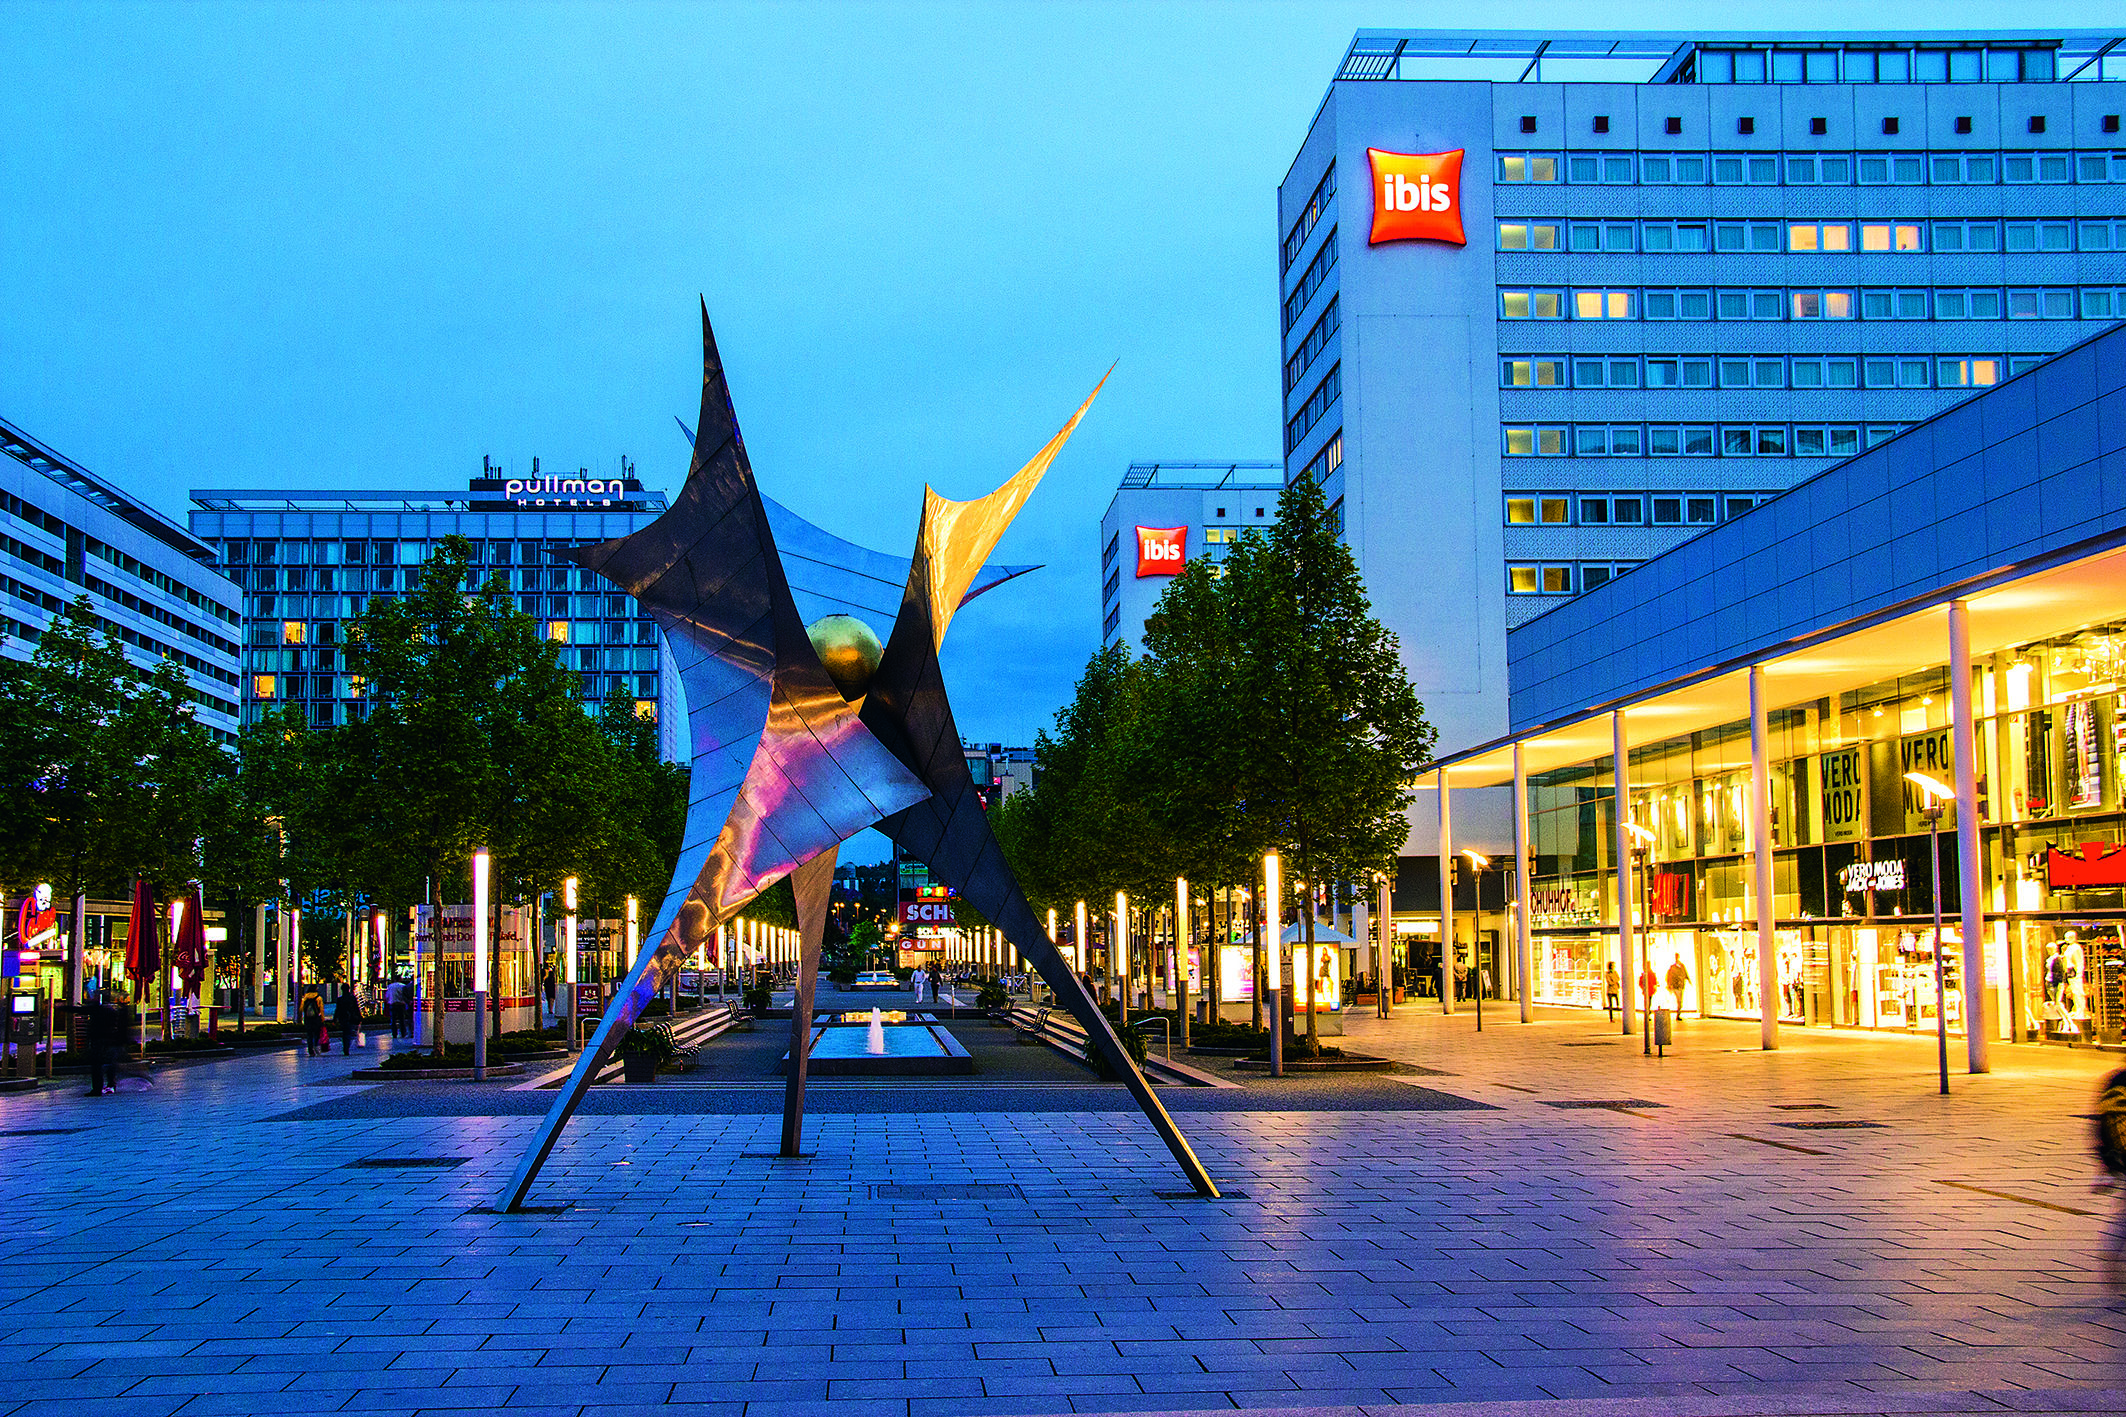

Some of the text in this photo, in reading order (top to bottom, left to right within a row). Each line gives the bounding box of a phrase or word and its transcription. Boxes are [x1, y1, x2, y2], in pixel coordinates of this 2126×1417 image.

[1384, 173, 1451, 212] ibis
[505, 475, 624, 501] pullman
[517, 498, 611, 507] HOTELS
[1144, 539, 1181, 561] ibis
[1901, 734, 1948, 774] VERO
[1821, 751, 1861, 789] VERO
[1846, 859, 1905, 879] VERO MODA
[1845, 875, 1905, 893] JACK JONES
[906, 904, 956, 921] SCH
[1531, 889, 1571, 915] CHUHHOF
